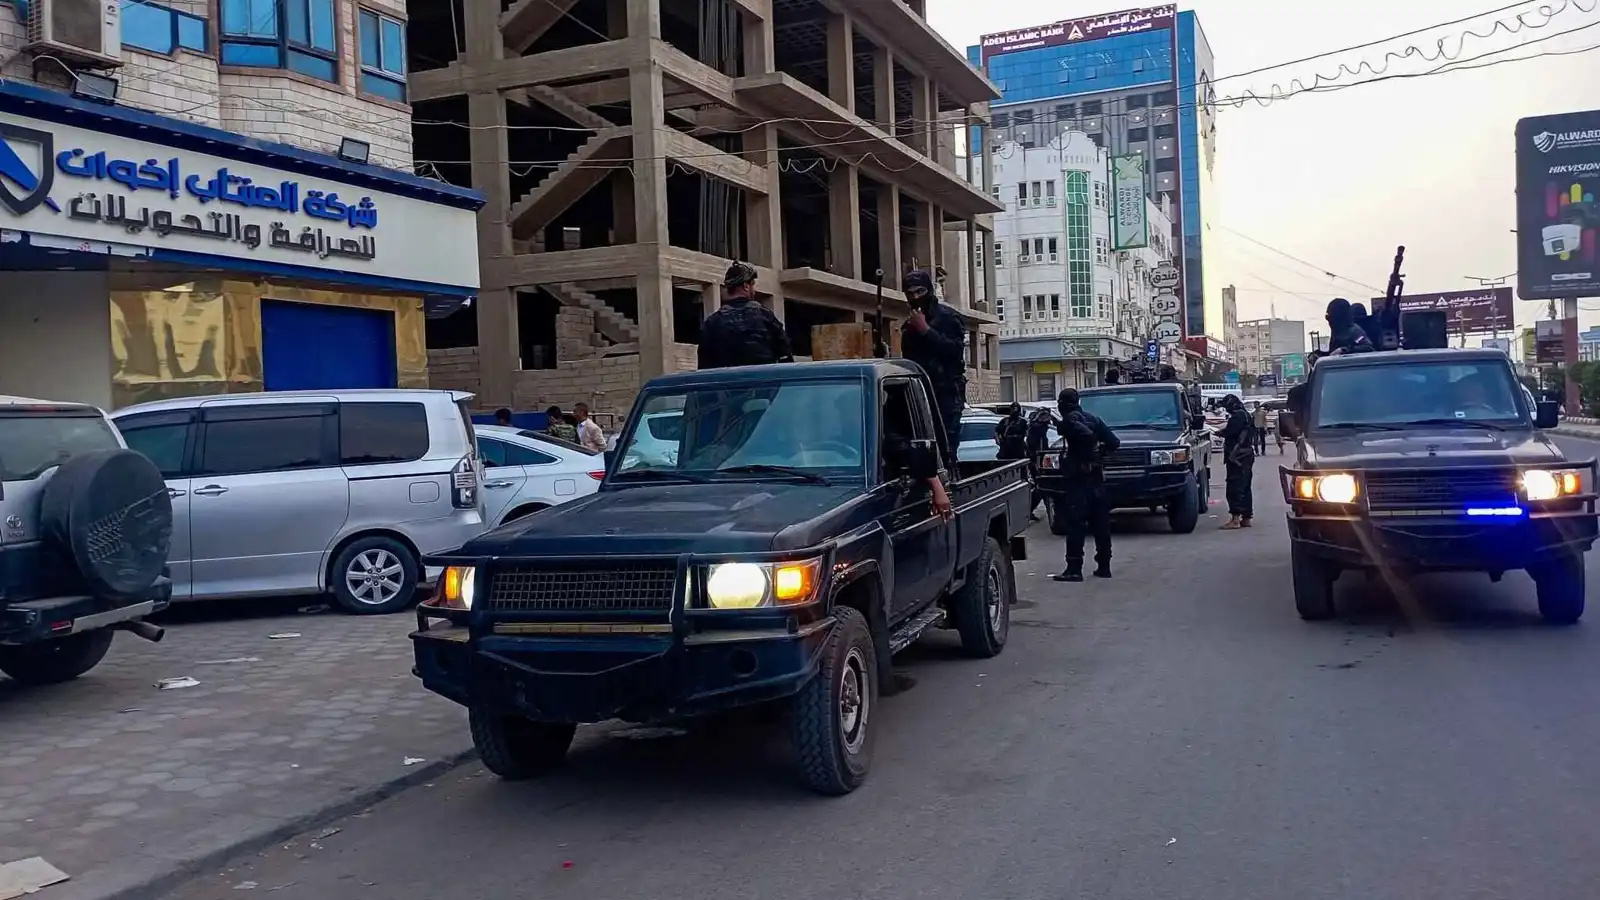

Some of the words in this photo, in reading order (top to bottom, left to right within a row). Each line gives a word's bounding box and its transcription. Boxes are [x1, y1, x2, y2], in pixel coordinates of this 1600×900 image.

[1131, 13, 1152, 24] عدن
[983, 37, 1006, 47] ADEN
[1006, 31, 1040, 43] ISLAMIC
[1040, 27, 1064, 38] BANK
[56, 148, 181, 200] إخوان
[1548, 162, 1600, 174] HIKVISION
[303, 190, 378, 229] شركة
[67, 192, 263, 250] والتحويلات
[268, 221, 376, 260] للصرافة
[1152, 270, 1178, 284] فندق
[1156, 299, 1176, 312] درة
[1155, 328, 1179, 340] عدن
